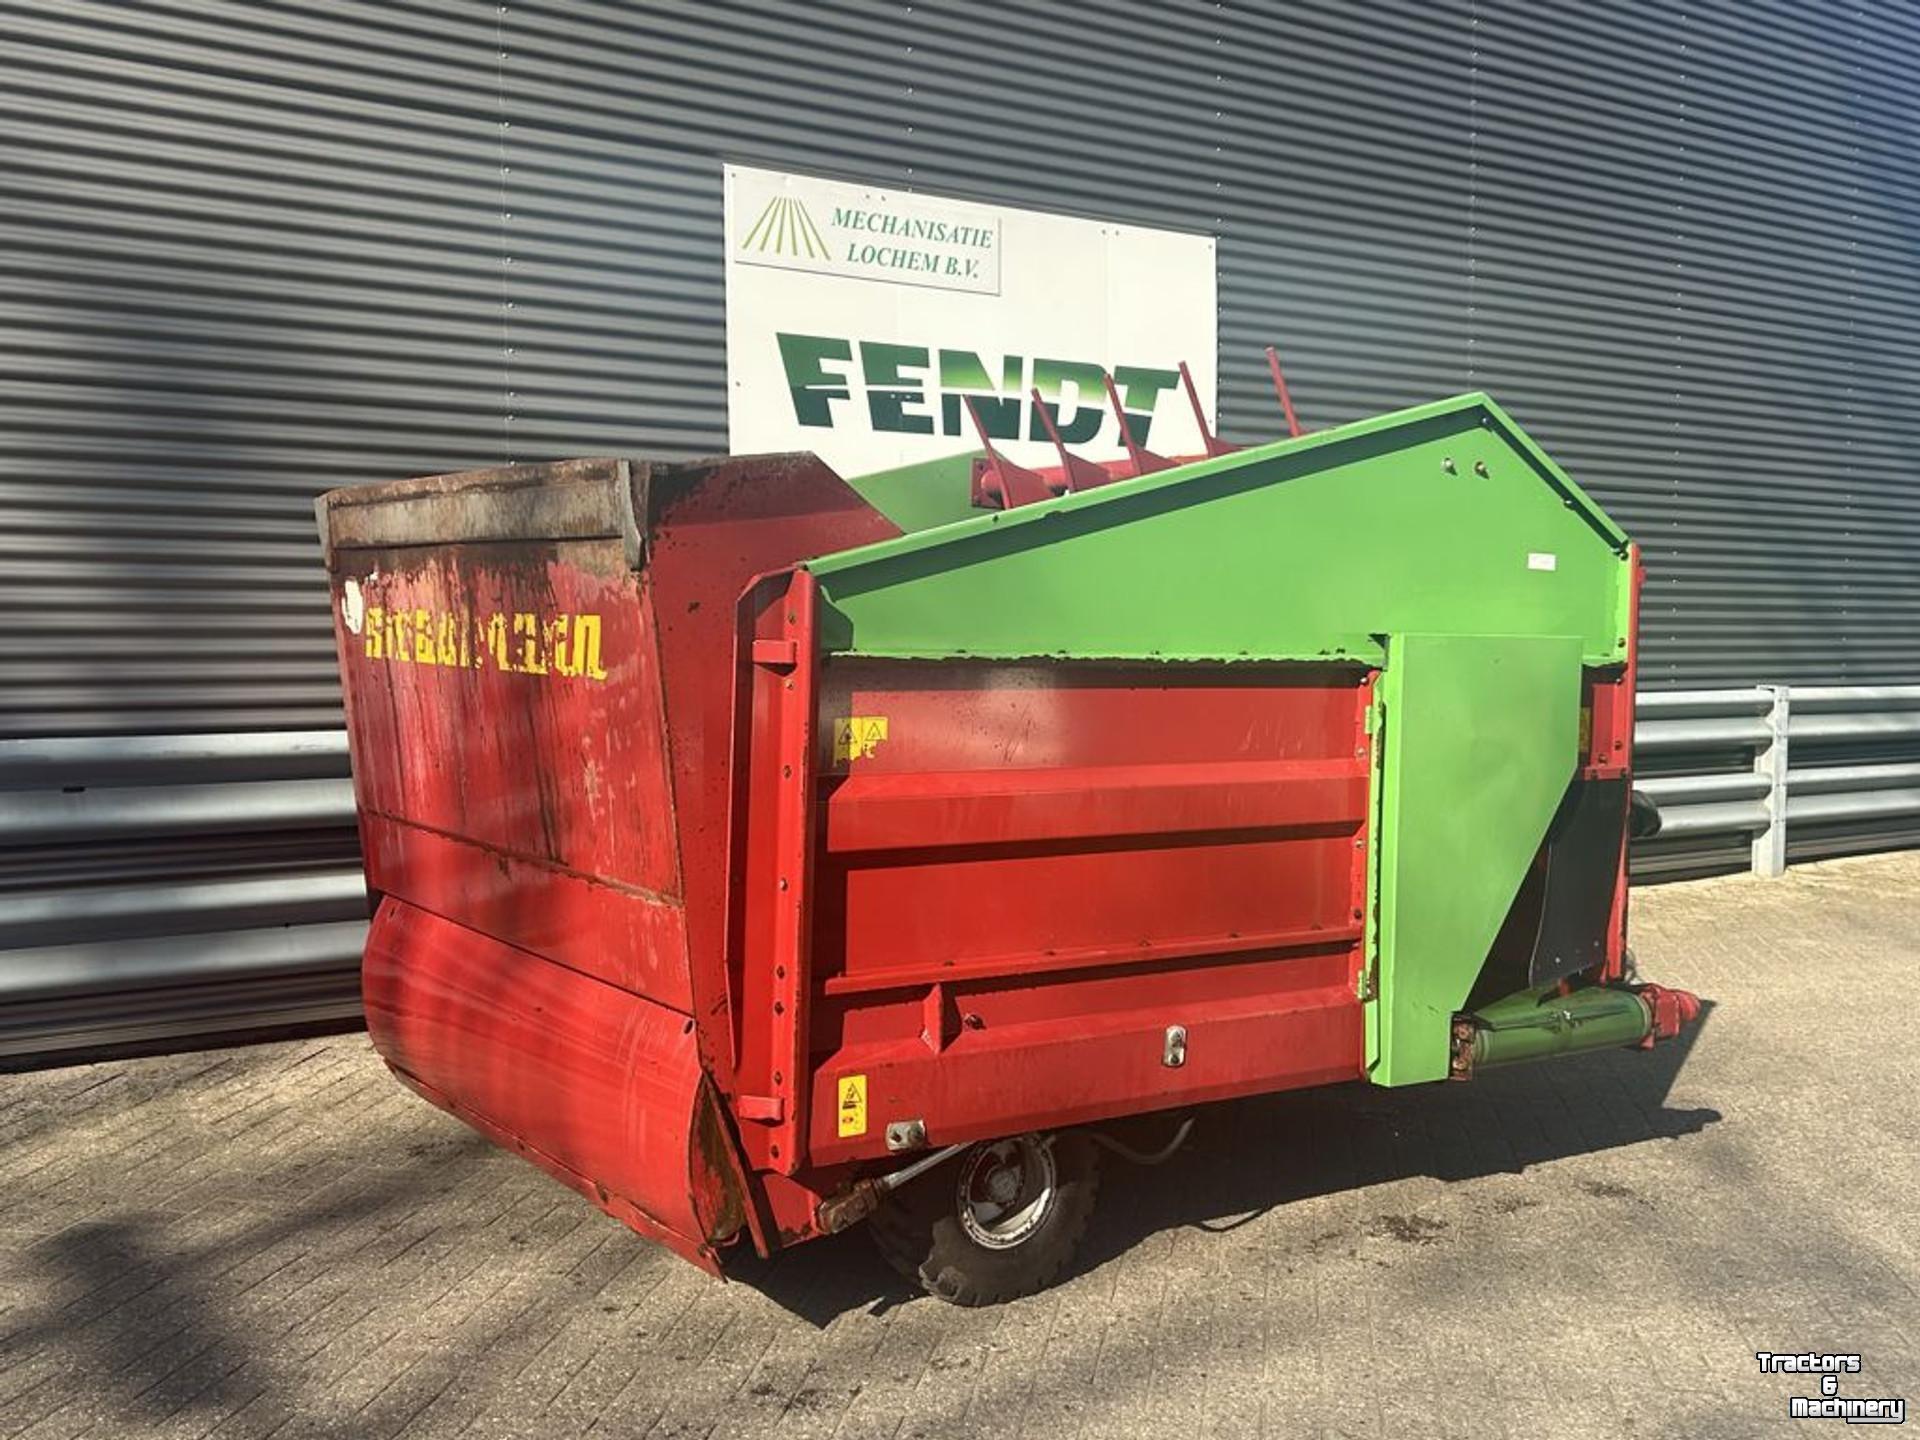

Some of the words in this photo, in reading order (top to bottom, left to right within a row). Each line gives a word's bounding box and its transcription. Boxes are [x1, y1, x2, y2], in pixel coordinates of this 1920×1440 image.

[831, 207, 993, 249] MECHANISATIE
[847, 243, 940, 273] LOCHEM
[945, 256, 979, 279] B.V.
[776, 332, 1181, 447] FENDT
